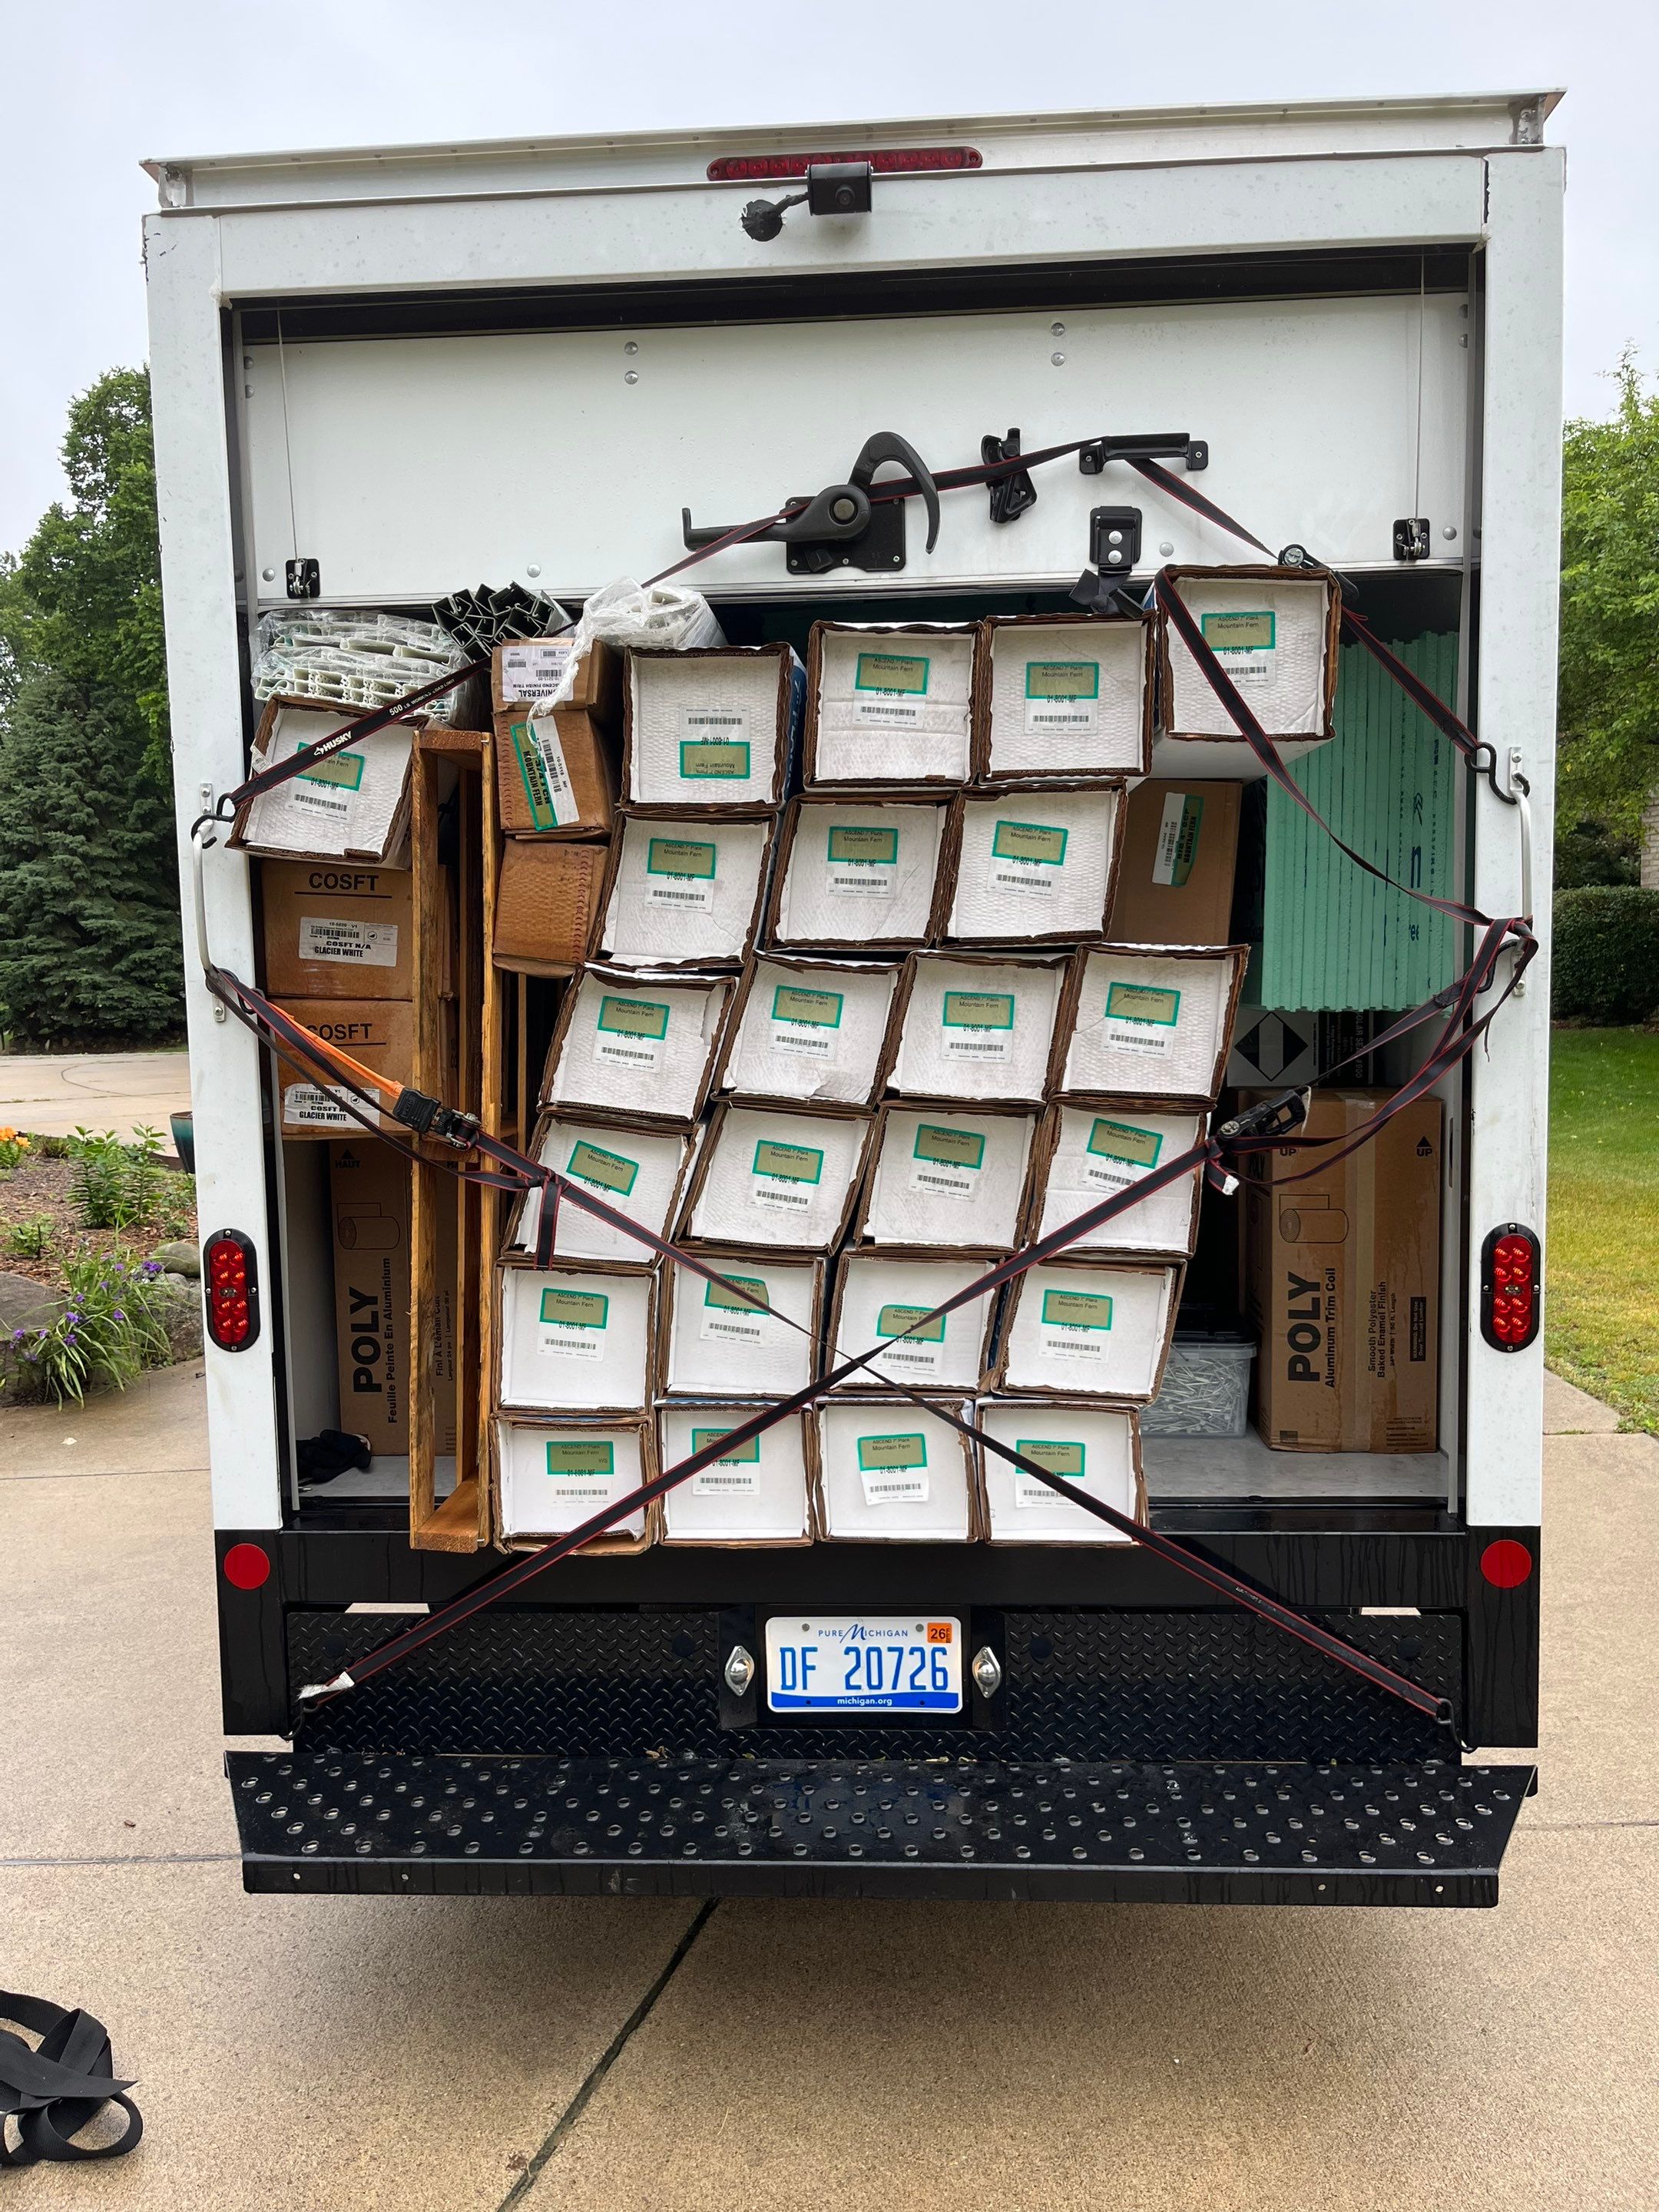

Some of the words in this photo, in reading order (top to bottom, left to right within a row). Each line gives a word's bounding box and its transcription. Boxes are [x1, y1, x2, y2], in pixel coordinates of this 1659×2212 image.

[518, 689, 556, 697] NIVERSAL
[389, 704, 403, 716] 500
[322, 730, 353, 752] HUSKY
[523, 751, 538, 788] MOUNTAIN
[532, 788, 542, 806] FERN
[1011, 832, 1037, 841] Mountain
[1184, 832, 1194, 863] MOUNTAIN
[309, 873, 379, 891] COSFT
[315, 946, 341, 955] GLACIER
[343, 949, 363, 958] WHITE
[790, 996, 814, 1005] Mountain
[1124, 994, 1150, 1002] Mountain
[616, 1007, 641, 1016] Mountain
[299, 1111, 326, 1120] GLACIER
[326, 1113, 347, 1121] WHITE
[932, 1135, 956, 1145] Mountain
[1107, 1131, 1132, 1142] Mountain
[1134, 1137, 1145, 1145] Fern
[770, 1151, 795, 1161] Mountain
[1279, 1147, 1296, 1157] UP
[1416, 1147, 1433, 1157] UP
[335, 1160, 361, 1168] HAUT
[588, 1154, 611, 1168] Mountain
[613, 1163, 624, 1172] Fern
[382, 1258, 392, 1320] Aluminium
[1325, 1268, 1335, 1292] Coil
[1058, 1300, 1084, 1309] Mountain
[1377, 1281, 1386, 1310] Finish
[1325, 1296, 1335, 1323] Trim
[1368, 1290, 1377, 1334] Polyester
[384, 1324, 393, 1339] En
[1287, 1271, 1321, 1382] POLY
[1377, 1312, 1386, 1346] Enamel
[349, 1286, 382, 1392] POLY
[385, 1343, 396, 1380] Peinte
[1325, 1327, 1335, 1388] Aluminum
[1368, 1337, 1376, 1372] Smooth
[1377, 1349, 1386, 1379] Baked
[387, 1384, 397, 1423] Feuille
[839, 1624, 908, 1644] MICHIGAN
[930, 1628, 946, 1639] 26
[779, 1647, 818, 1690] DF
[844, 1647, 949, 1690] 20726
[837, 1697, 892, 1707] michigan.org
